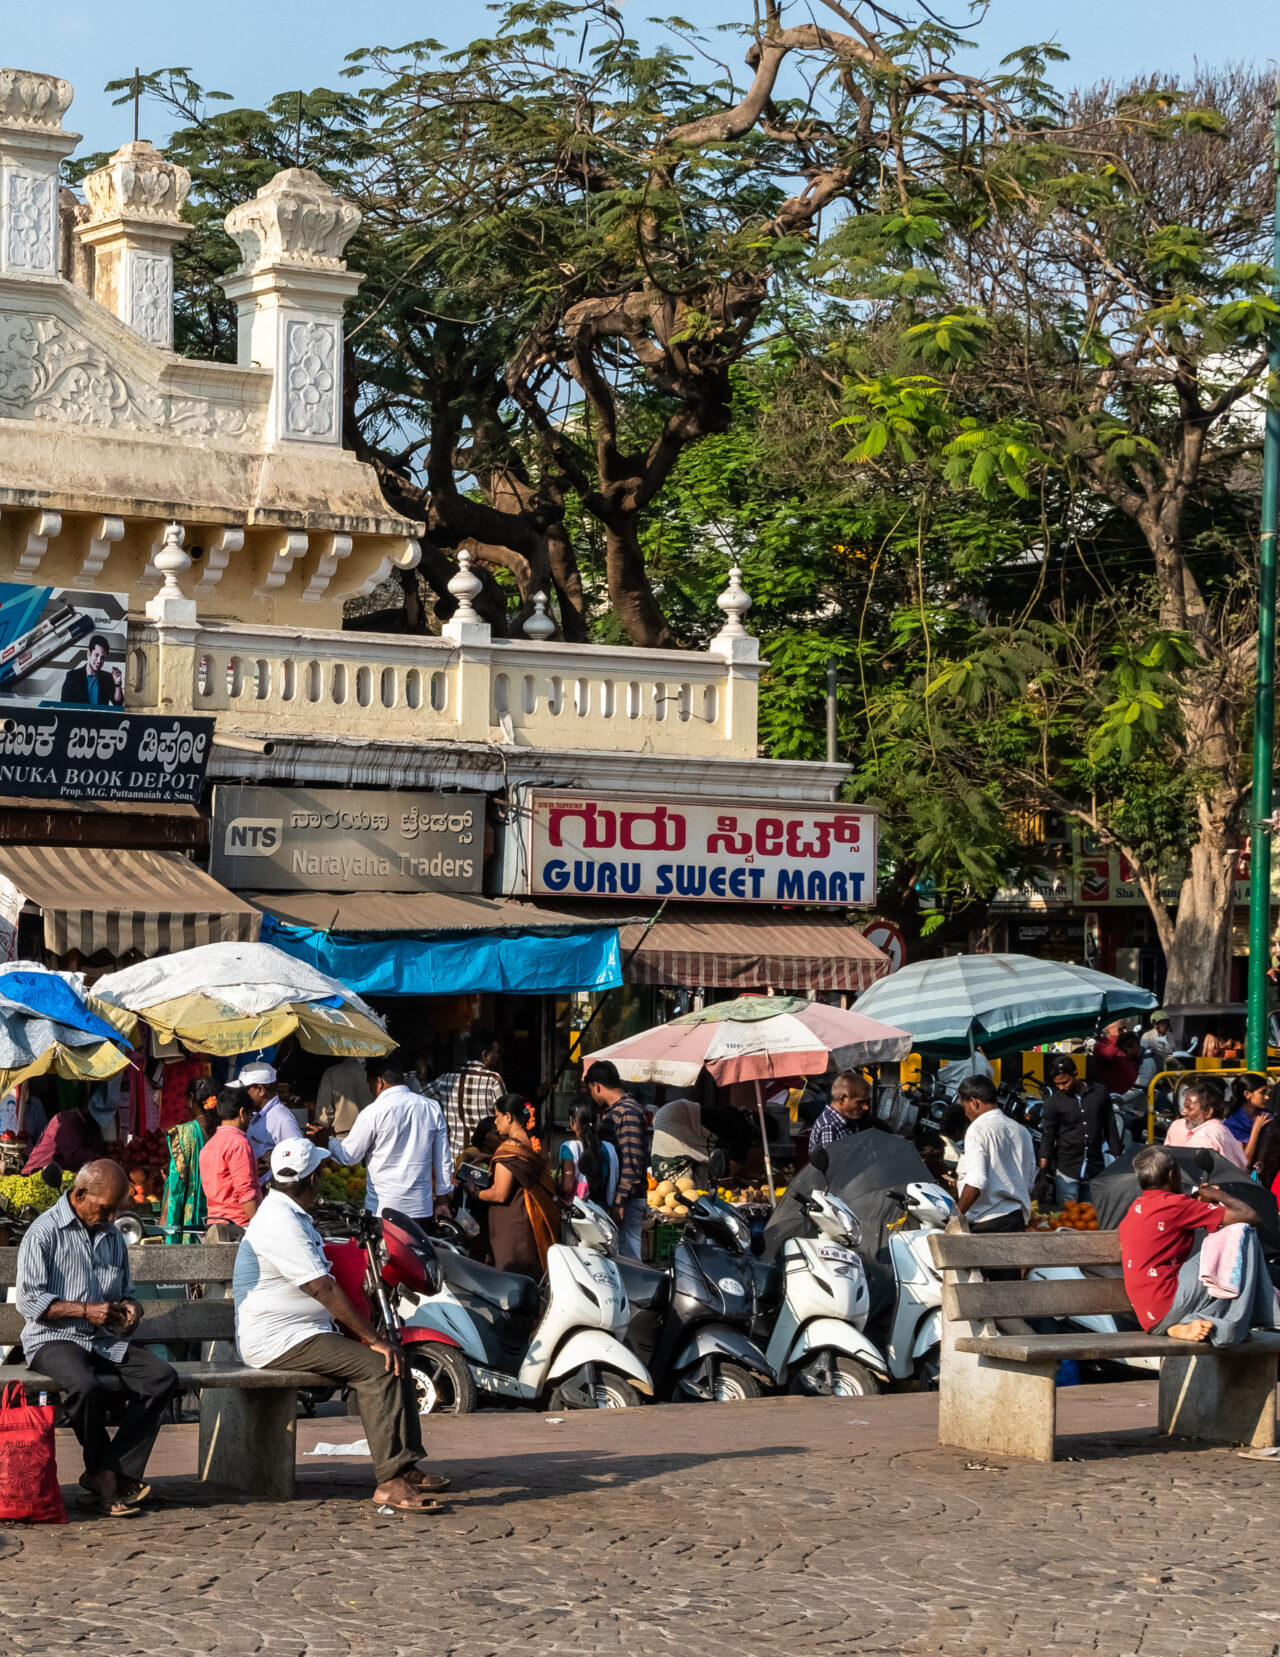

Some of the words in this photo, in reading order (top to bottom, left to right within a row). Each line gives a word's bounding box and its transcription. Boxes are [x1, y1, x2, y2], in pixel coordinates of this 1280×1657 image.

[67, 720, 130, 760] ಬುಕ್
[64, 769, 123, 787] BOOK
[128, 772, 200, 790] DEPOT
[60, 786, 84, 797] Prop.
[85, 787, 108, 797] M.G.
[110, 789, 162, 800] Puttannaiah
[163, 790, 172, 800] &
[174, 791, 197, 801] Sons.
[230, 825, 277, 848] NTS
[548, 803, 686, 852] ಗುರು
[291, 849, 389, 881] Narayana
[396, 852, 473, 878] Traders
[543, 859, 641, 894] GURU
[656, 864, 765, 899] SWEET
[776, 868, 865, 902] MART
[1116, 888, 1135, 898] Sha
